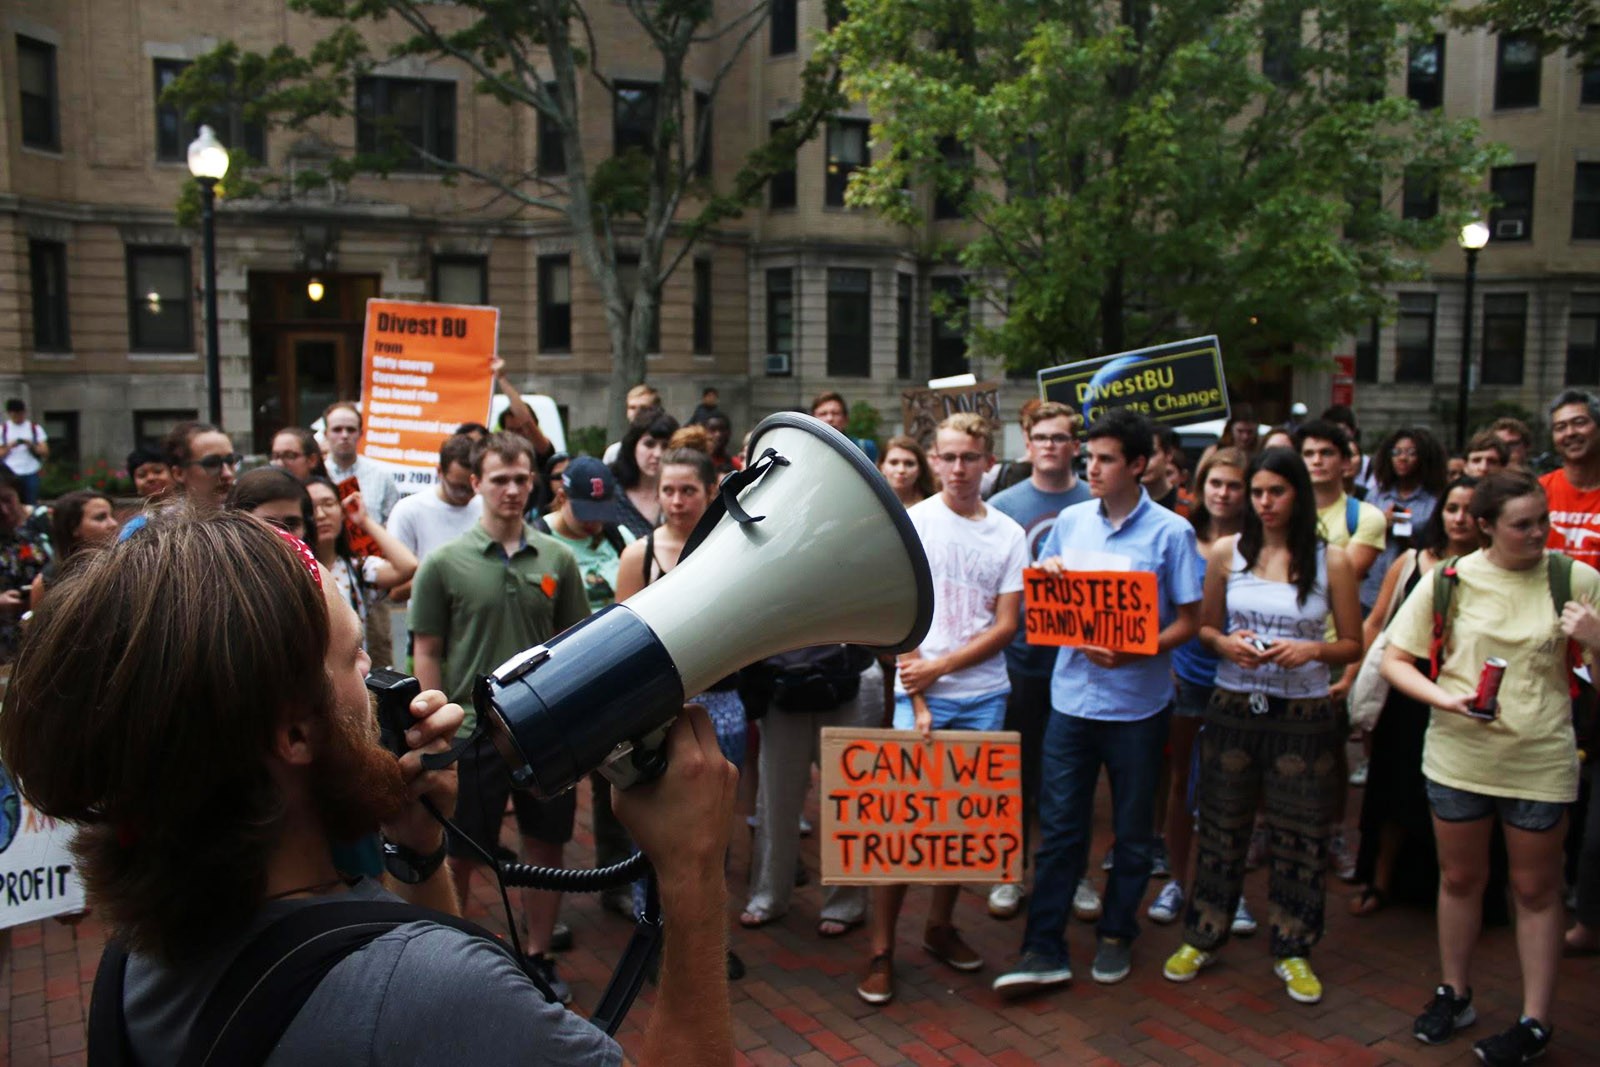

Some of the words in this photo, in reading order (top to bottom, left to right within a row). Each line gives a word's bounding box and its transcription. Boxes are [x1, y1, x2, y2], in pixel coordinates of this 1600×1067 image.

[377, 311, 437, 335] Divest
[442, 316, 467, 339] BU
[374, 340, 403, 354] from
[1075, 365, 1175, 404] DivestBU
[1152, 388, 1220, 413] Change
[590, 477, 605, 497] B
[1028, 577, 1152, 613] TRUSTEES,
[1027, 607, 1077, 637] STAND
[1077, 609, 1124, 649] WITH
[1126, 616, 1147, 644] US
[842, 744, 923, 782] CAN
[947, 746, 1006, 782] WE
[829, 792, 941, 823] TRUST
[957, 793, 1010, 820] OUR
[836, 832, 1019, 880] TRUSTEES?
